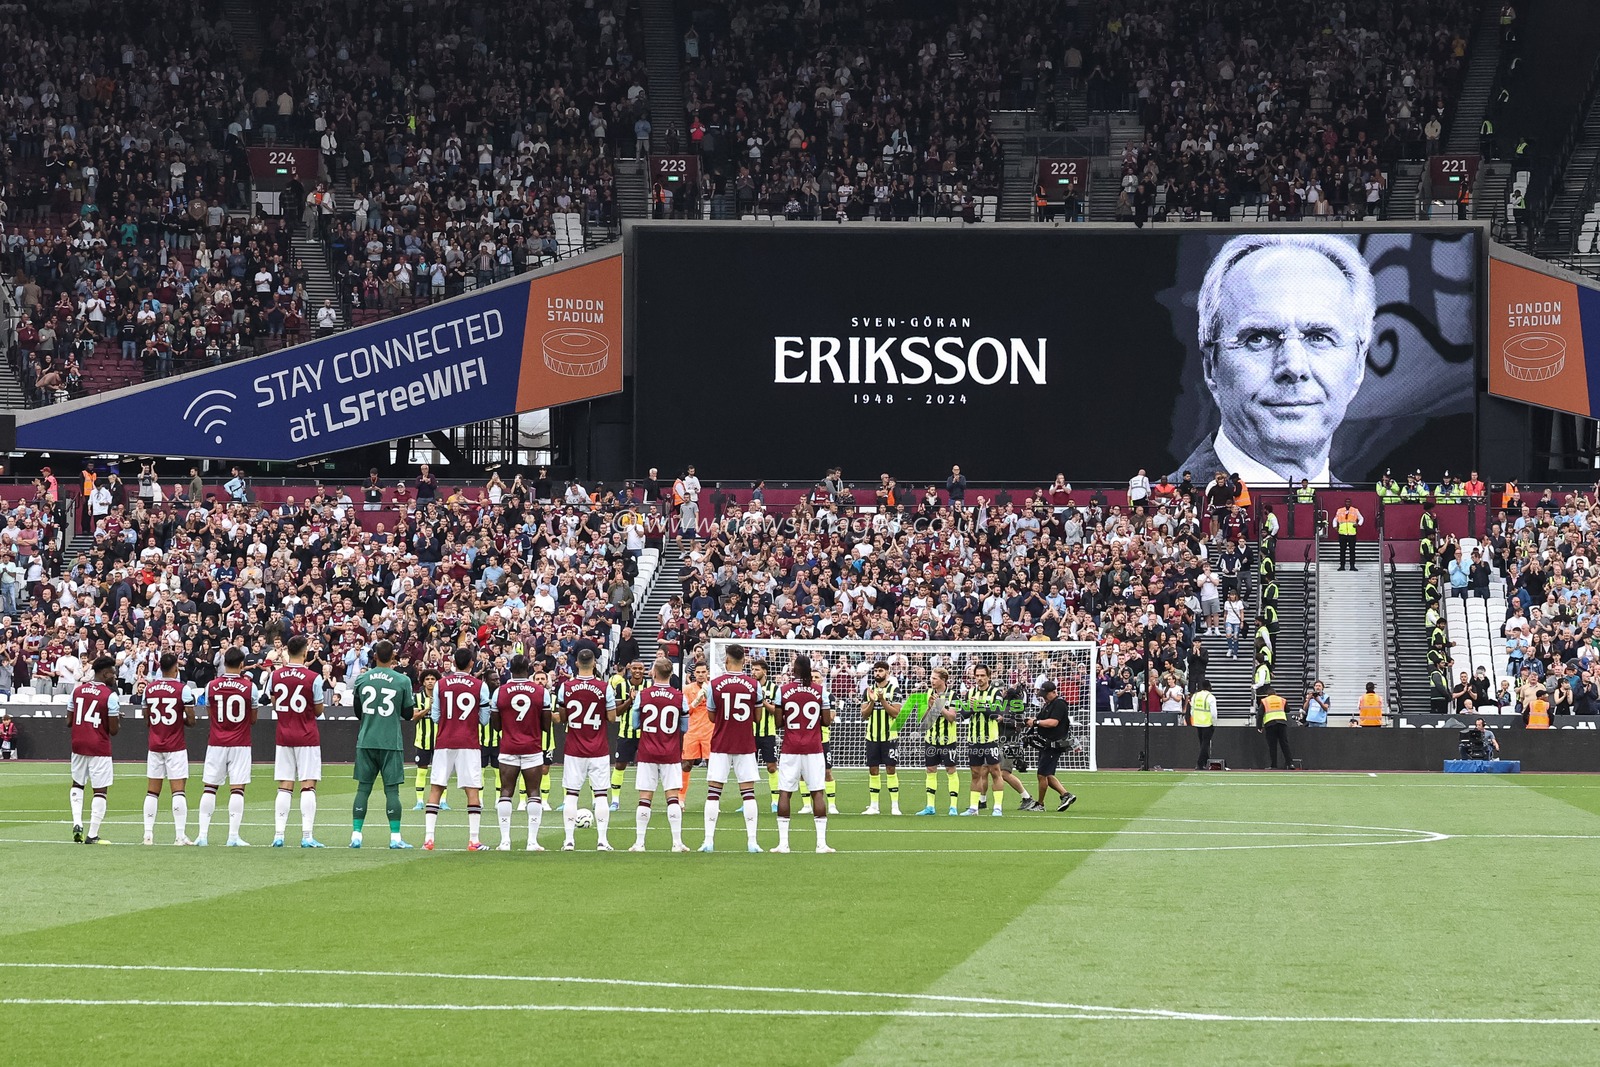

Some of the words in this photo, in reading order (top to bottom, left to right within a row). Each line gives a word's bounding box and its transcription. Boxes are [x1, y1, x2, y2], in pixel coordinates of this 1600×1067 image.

[269, 151, 296, 165] 224
[660, 159, 686, 172] 223
[1051, 162, 1077, 175] 222
[1442, 159, 1468, 172] 221
[547, 297, 604, 311] LONDON
[1508, 301, 1561, 315] LONDON
[547, 310, 604, 324] STADIUM
[851, 316, 971, 328] SVEN-GÖRAN
[1508, 314, 1561, 327] STADIUM
[253, 359, 326, 408] STAY
[333, 308, 504, 384] CONNECTED
[774, 336, 1047, 385] ERIKSSON
[289, 407, 320, 443] at
[323, 356, 488, 432] LSFreeWIFI
[854, 394, 894, 404] 1948
[926, 394, 967, 404] 2024
[280, 671, 306, 681] KILMAN
[81, 686, 101, 696] KUDUS
[148, 684, 176, 694] EMERSON
[506, 684, 536, 694] ANTONIO
[571, 683, 605, 700] RODRIGUEZ
[650, 690, 674, 700] BOWEN
[782, 686, 821, 700] WAN-BISSAKA
[274, 683, 307, 714] 26
[361, 685, 397, 717] 23
[75, 697, 102, 728] 14
[146, 697, 178, 726] 33
[214, 694, 246, 723] 10
[444, 691, 476, 721] 19
[510, 693, 531, 722] 9
[721, 692, 752, 722] 15
[566, 699, 602, 730] 24
[642, 703, 680, 735] 20
[784, 701, 821, 730] 29
[989, 747, 999, 757] 10
